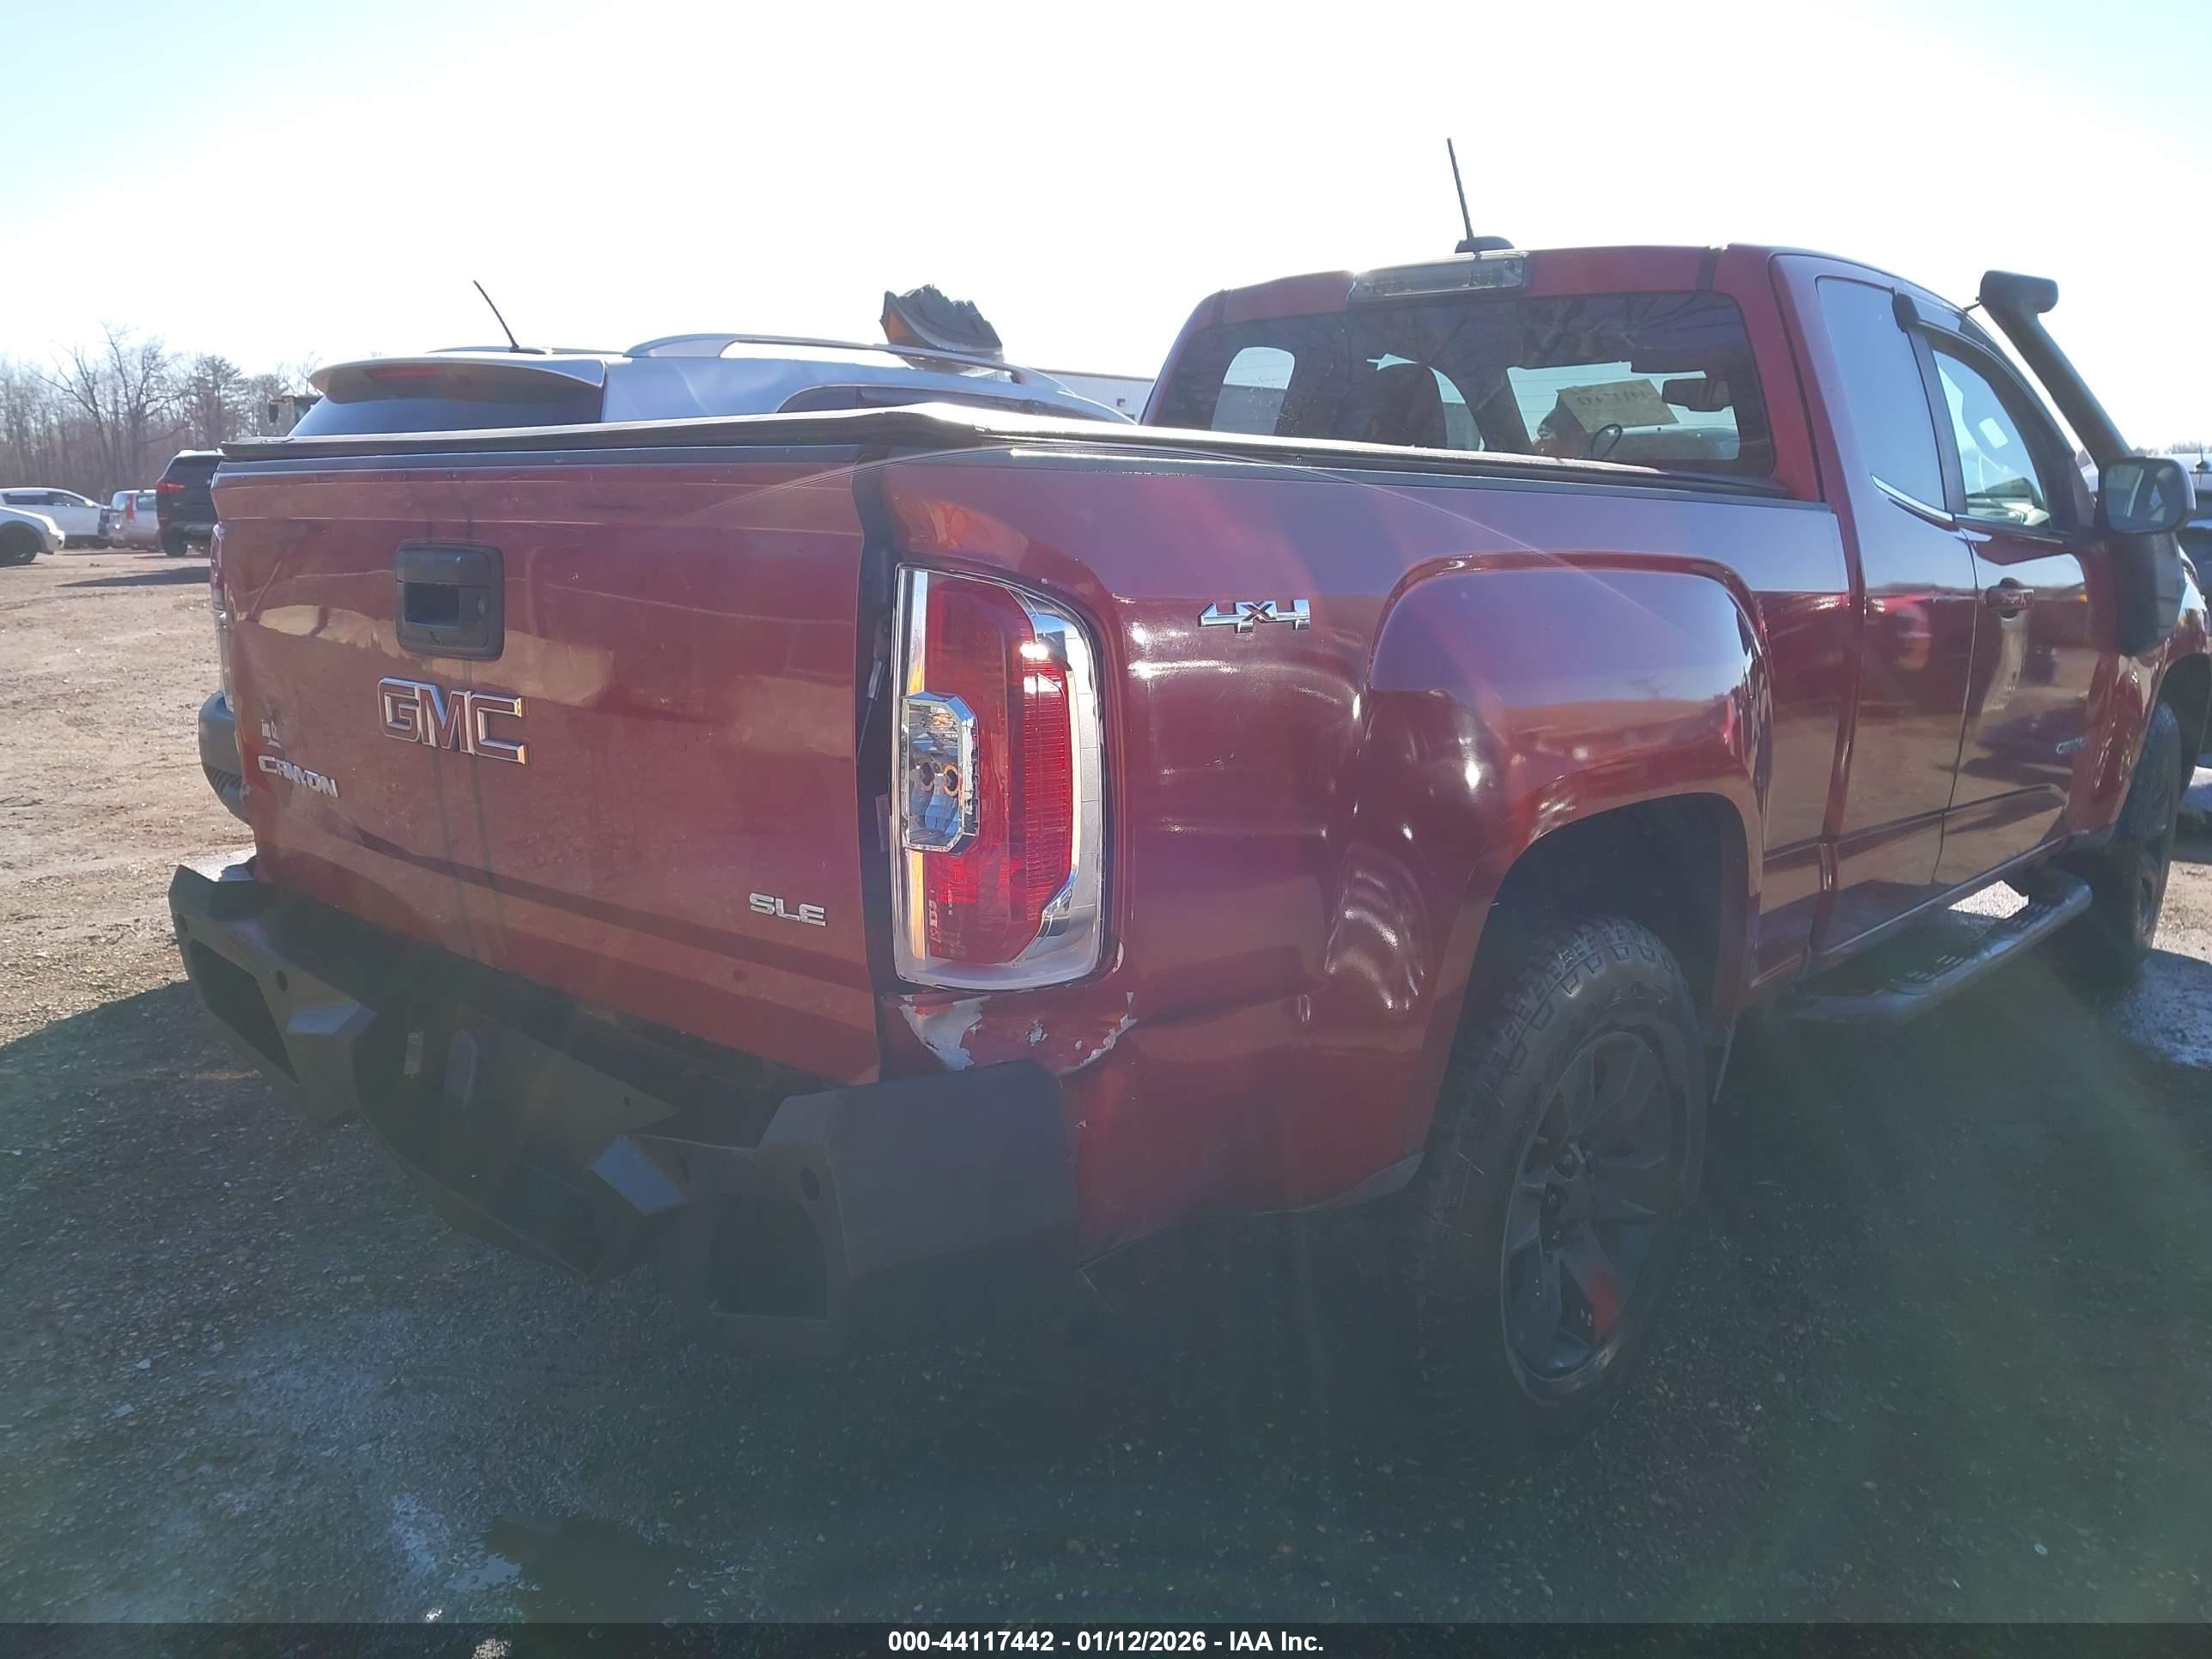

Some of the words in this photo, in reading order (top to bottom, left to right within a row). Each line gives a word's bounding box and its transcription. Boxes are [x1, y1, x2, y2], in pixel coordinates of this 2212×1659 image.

[377, 676, 527, 765] GMC
[258, 755, 338, 798] CANYON
[749, 892, 826, 927] SLE
